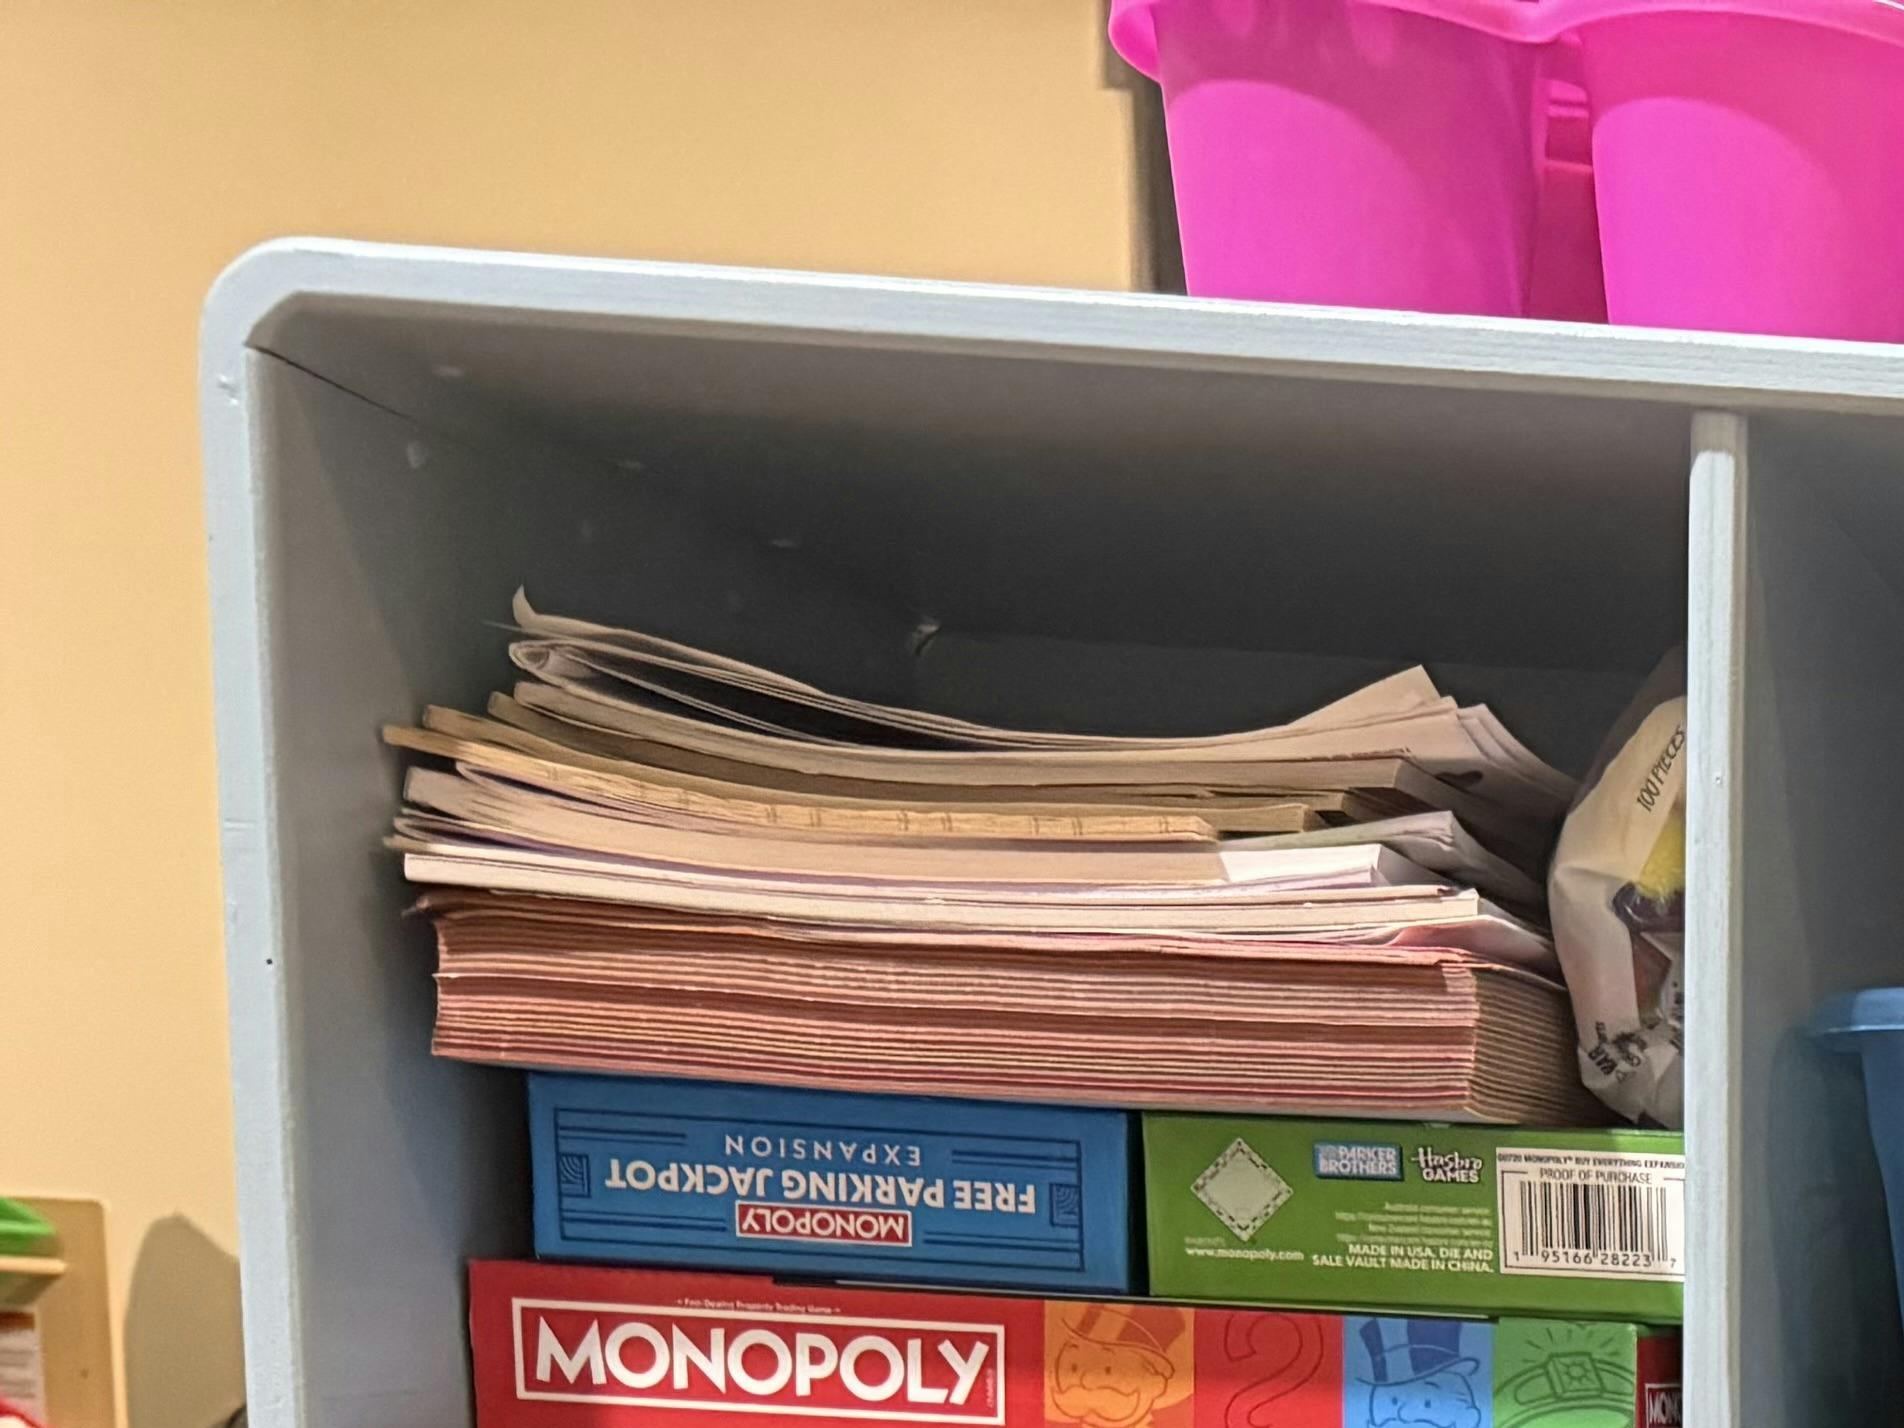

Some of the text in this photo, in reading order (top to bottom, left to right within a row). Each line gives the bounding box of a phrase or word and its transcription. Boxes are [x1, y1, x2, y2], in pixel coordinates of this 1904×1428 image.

[1637, 724, 1686, 812] 100 PIECES
[725, 1134, 921, 1167] EXPANSION
[1338, 1145, 1396, 1161] PARKER
[1410, 1146, 1483, 1170] Hasbro
[1319, 1158, 1397, 1176] BROTHERS
[1422, 1168, 1479, 1183] GAMES
[1539, 1167, 1652, 1184] PROOF OF PURCHASE
[604, 1158, 1036, 1214] FREE PARKING JACKPOT
[741, 1207, 904, 1239] MONOPOLY
[1185, 1246, 1305, 1262] www.monopoly.com
[1348, 1243, 1388, 1256] MADE
[1390, 1244, 1404, 1257] IN
[1439, 1247, 1461, 1259] DIE
[1462, 1248, 1493, 1261] AND
[1540, 1248, 1593, 1265] 95166
[1600, 1253, 1652, 1267] 28223
[1312, 1254, 1495, 1273] SALE VAULT MADE IN CHINA.
[535, 1316, 990, 1405] MONOPOLY
